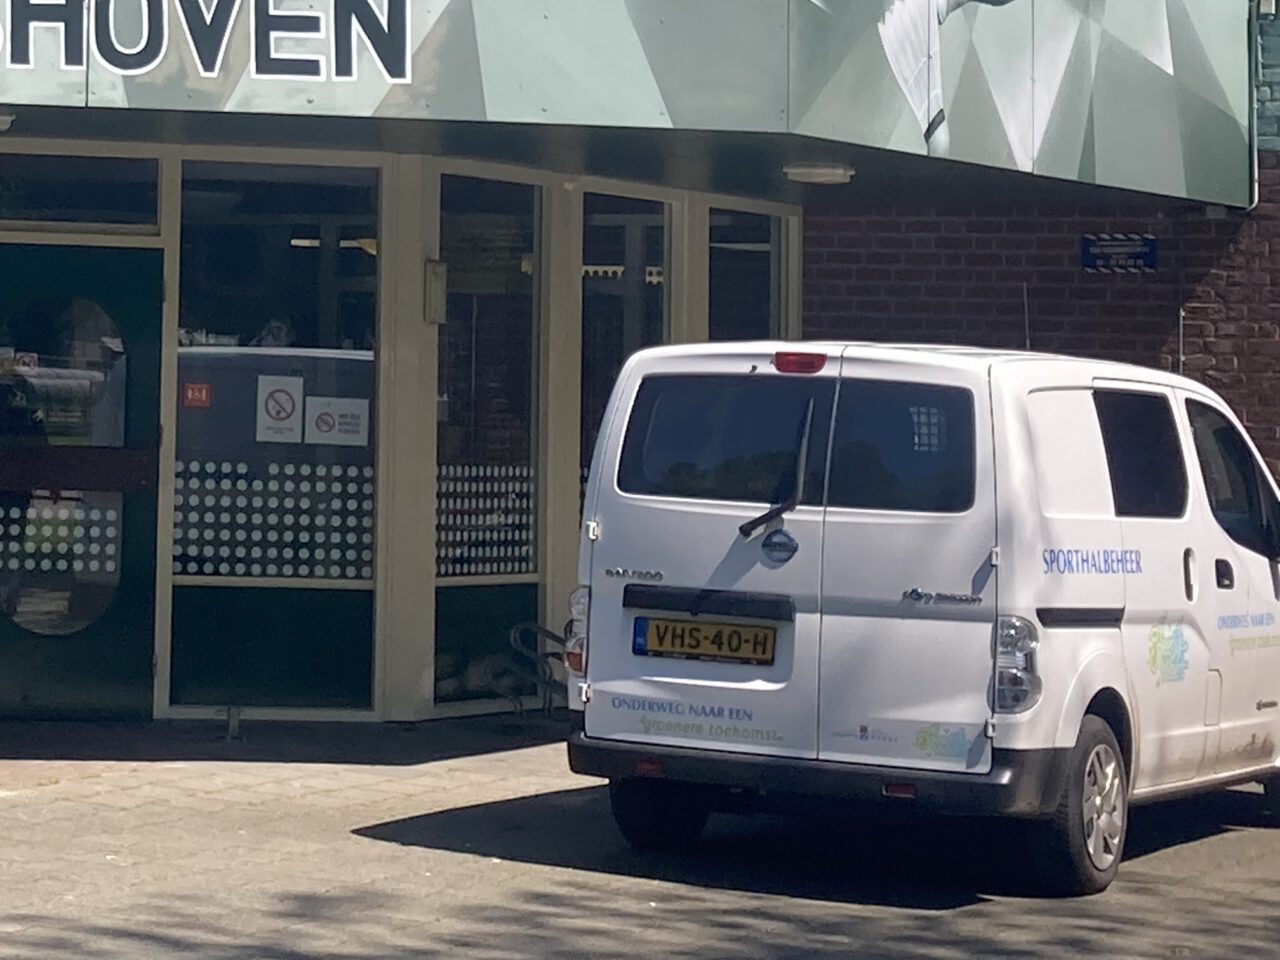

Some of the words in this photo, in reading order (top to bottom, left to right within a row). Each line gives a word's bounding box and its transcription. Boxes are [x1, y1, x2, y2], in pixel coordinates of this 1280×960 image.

[1042, 548, 1142, 574] SPORTHALBEHEER
[655, 624, 769, 656] VHS-40-H
[688, 704, 725, 719] NAAR
